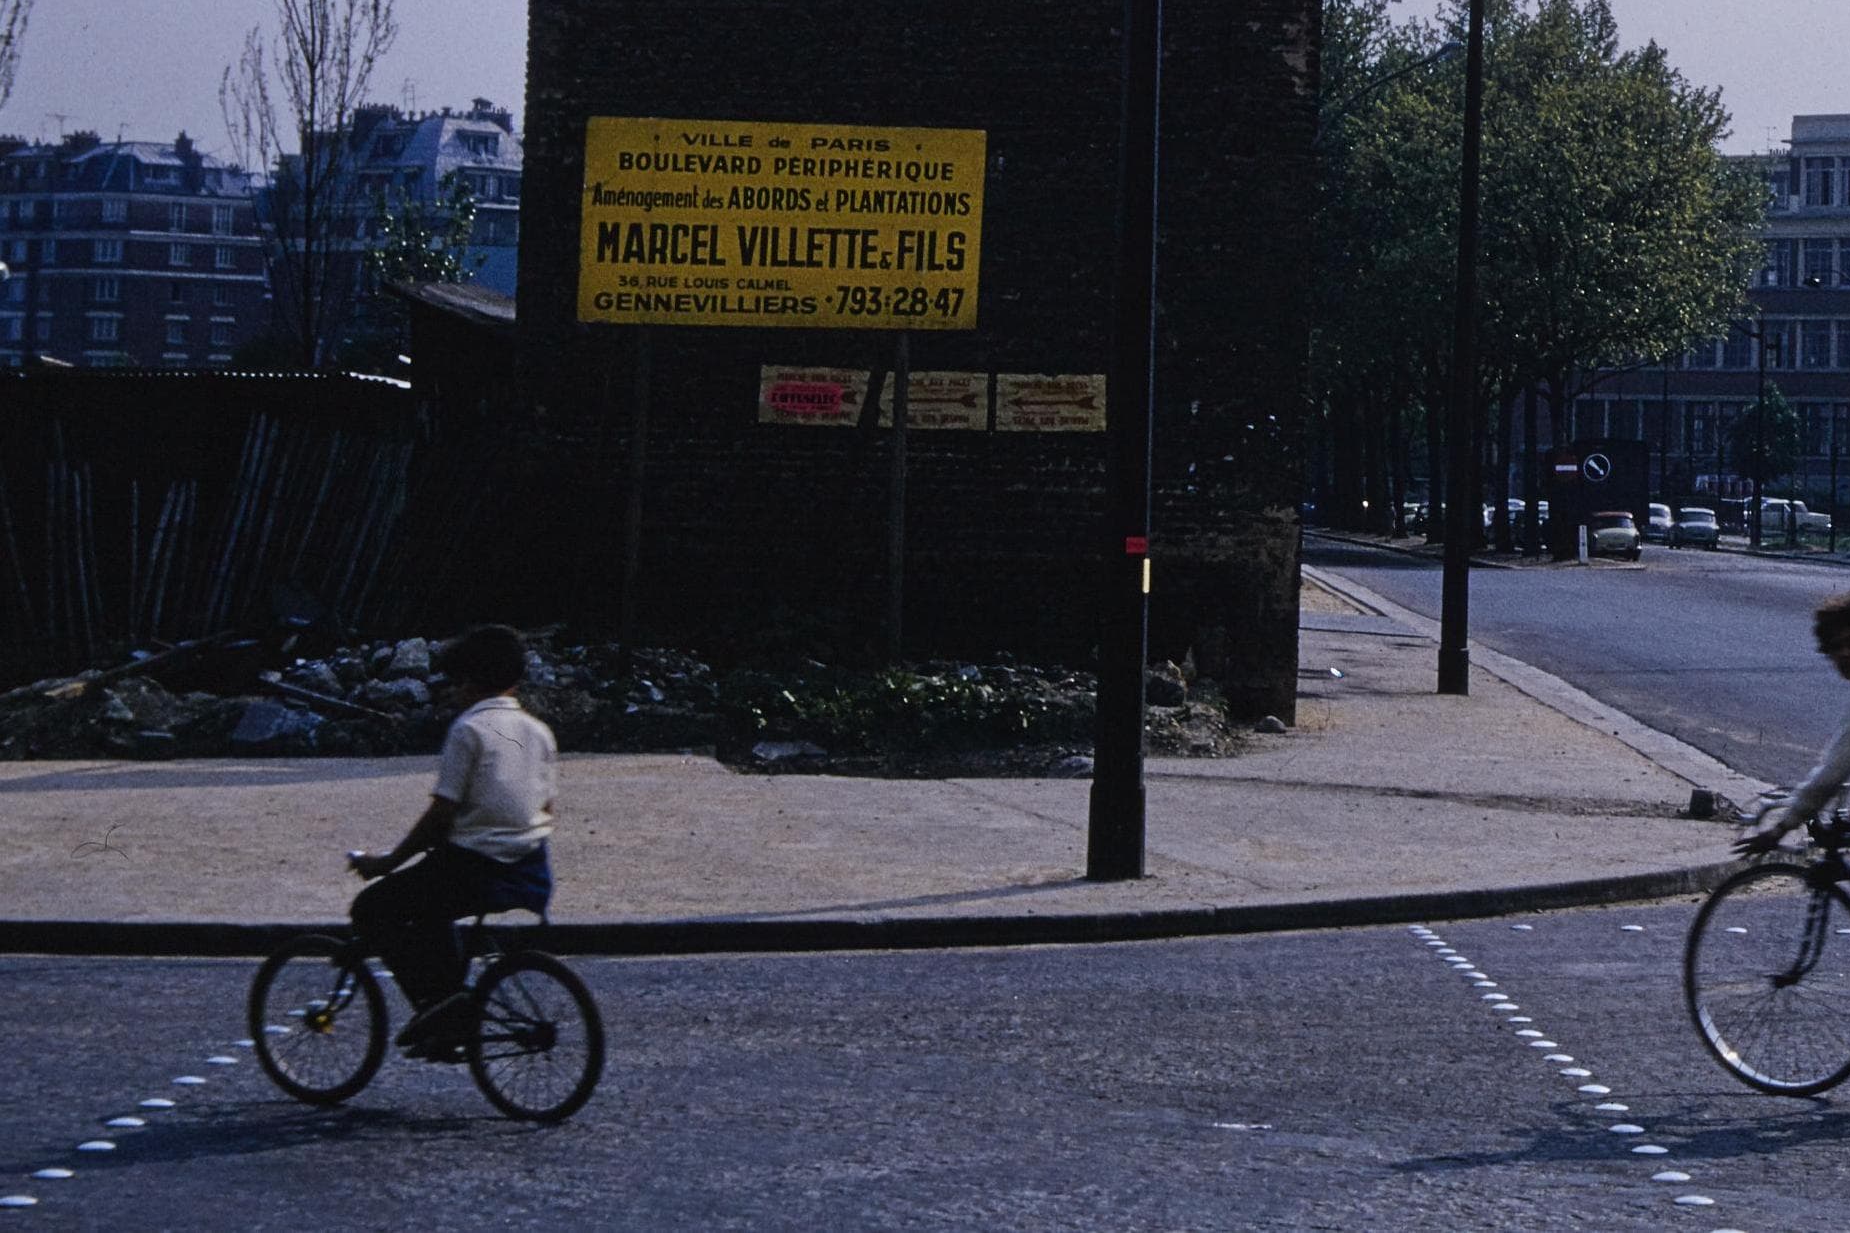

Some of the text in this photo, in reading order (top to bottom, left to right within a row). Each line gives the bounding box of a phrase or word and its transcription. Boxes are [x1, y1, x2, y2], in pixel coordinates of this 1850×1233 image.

[681, 132, 891, 152] VILLE de PARIS
[619, 152, 954, 182] BOULEVARD PÉRIPHÉRIQUE
[592, 181, 971, 216] Aménagement des ABORDS et PLANTATIONS
[597, 221, 966, 272] MARCEL VILLETTE & FILS
[646, 275, 678, 288] RUE
[684, 277, 729, 290] LOUIS
[736, 278, 791, 291] CALMEL
[593, 291, 818, 315] GENNEVILLIERS
